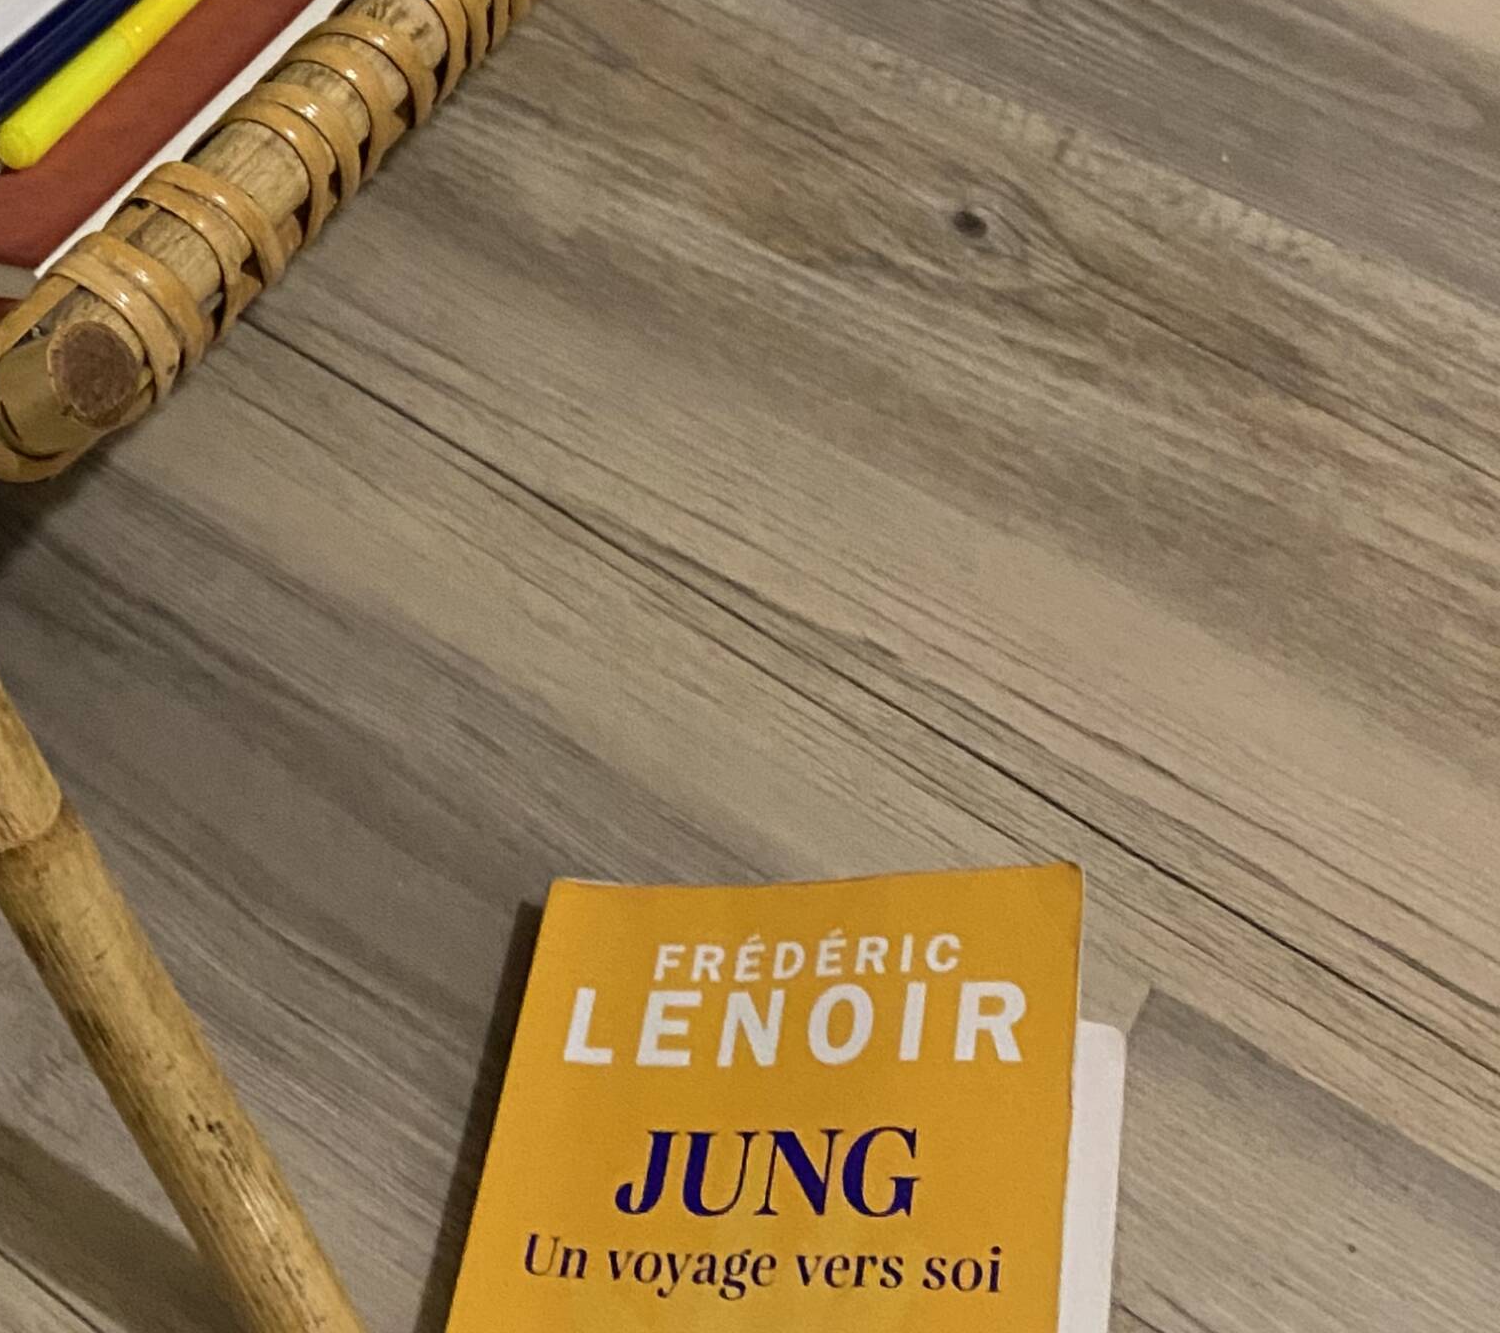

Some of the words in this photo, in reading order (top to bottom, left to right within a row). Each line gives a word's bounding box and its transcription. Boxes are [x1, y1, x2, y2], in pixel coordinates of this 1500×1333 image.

[653, 927, 962, 981] FRÉDÉRIC
[563, 979, 1028, 1068] LENOIR
[614, 1126, 921, 1218] JUNG
[523, 1233, 588, 1280] Un
[607, 1247, 777, 1301] voyage
[795, 1253, 904, 1291] vers
[922, 1244, 1003, 1294] soi
